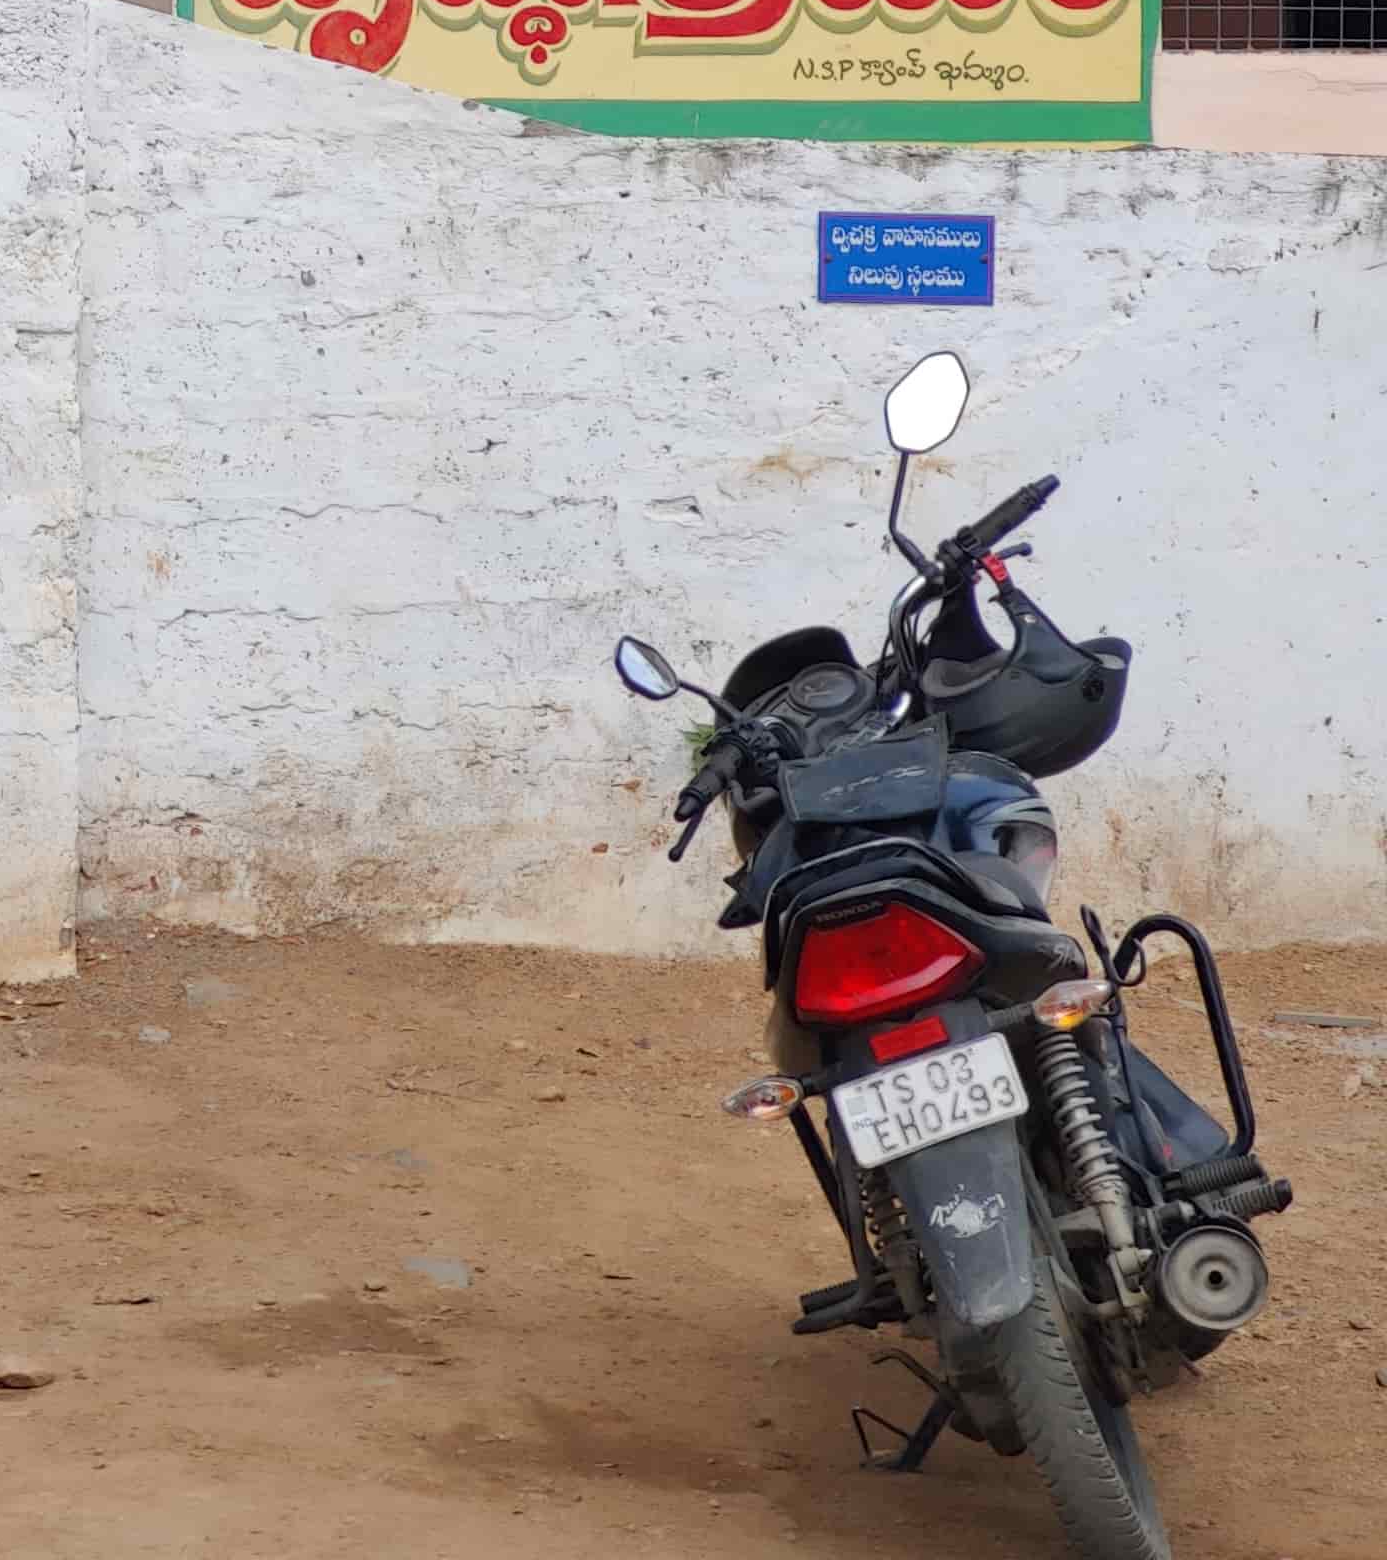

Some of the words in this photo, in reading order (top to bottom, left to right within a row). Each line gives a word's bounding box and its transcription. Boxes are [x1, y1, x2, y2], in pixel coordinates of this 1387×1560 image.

[882, 225, 981, 248] వాహనములు
[814, 901, 882, 923] HONDA
[868, 1073, 915, 1115] TS
[925, 1052, 974, 1093] 03
[873, 1075, 1015, 1152] EH0493
